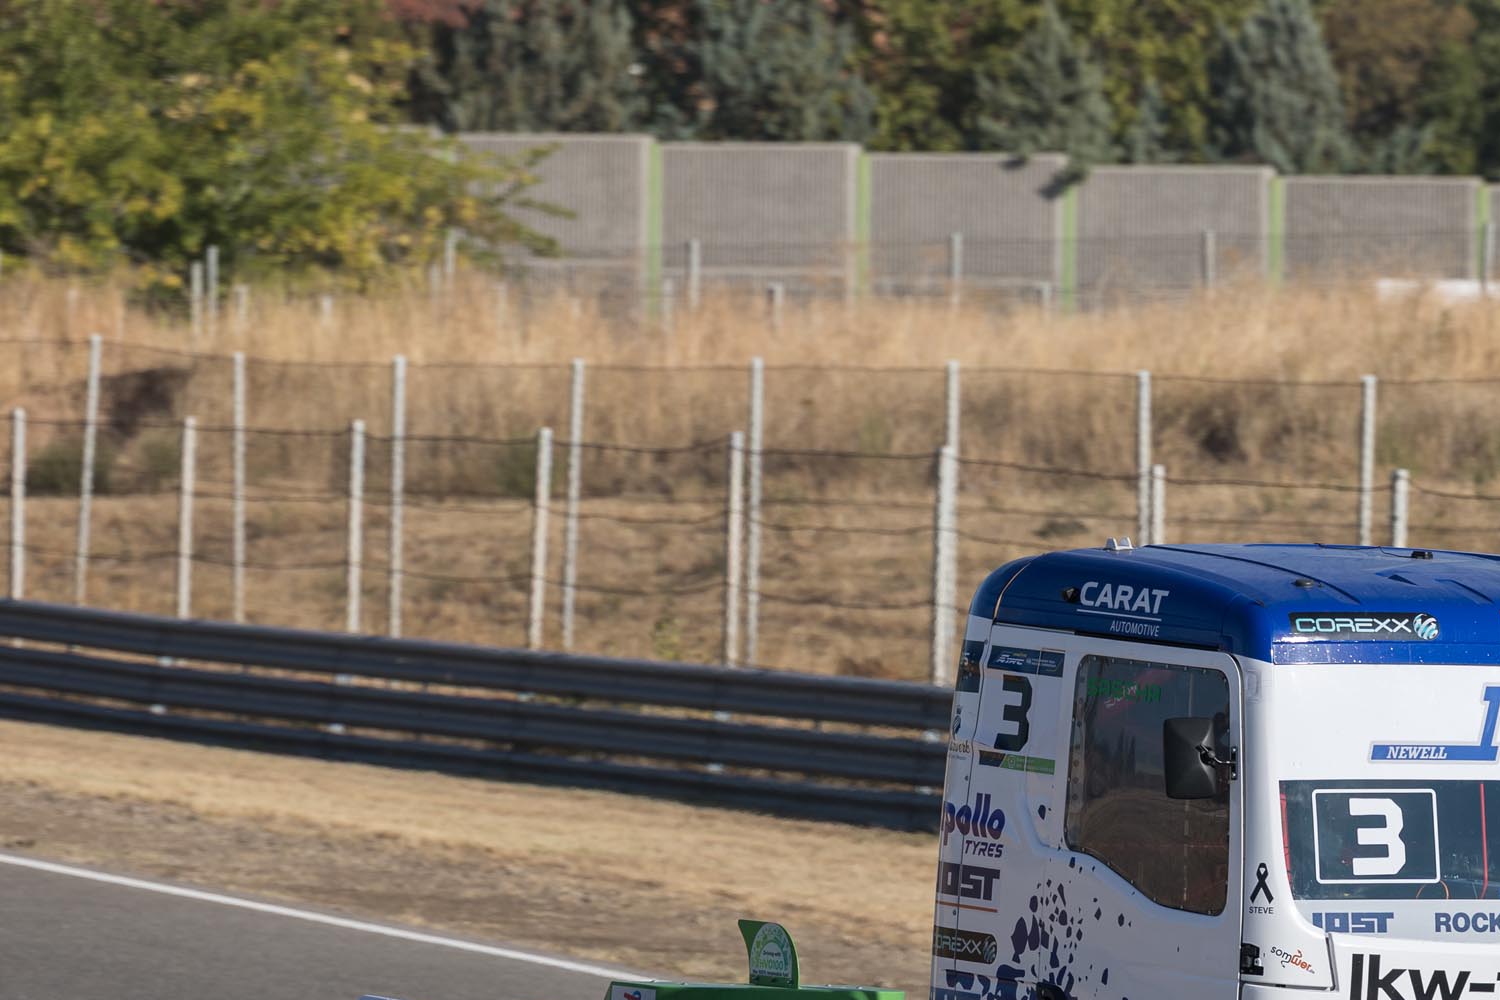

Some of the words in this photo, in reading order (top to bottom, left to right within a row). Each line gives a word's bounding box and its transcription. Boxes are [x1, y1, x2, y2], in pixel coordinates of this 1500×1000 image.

[1080, 581, 1169, 614] CARAT
[1110, 620, 1160, 637] AUTOMOTIVE
[1296, 617, 1411, 633] COREXX
[994, 674, 1032, 752] 3
[1386, 746, 1448, 759] NEWELL
[1349, 798, 1406, 875] 3
[965, 840, 1003, 858] TYRES
[938, 861, 1000, 901] OST
[1248, 906, 1274, 914] STEVE
